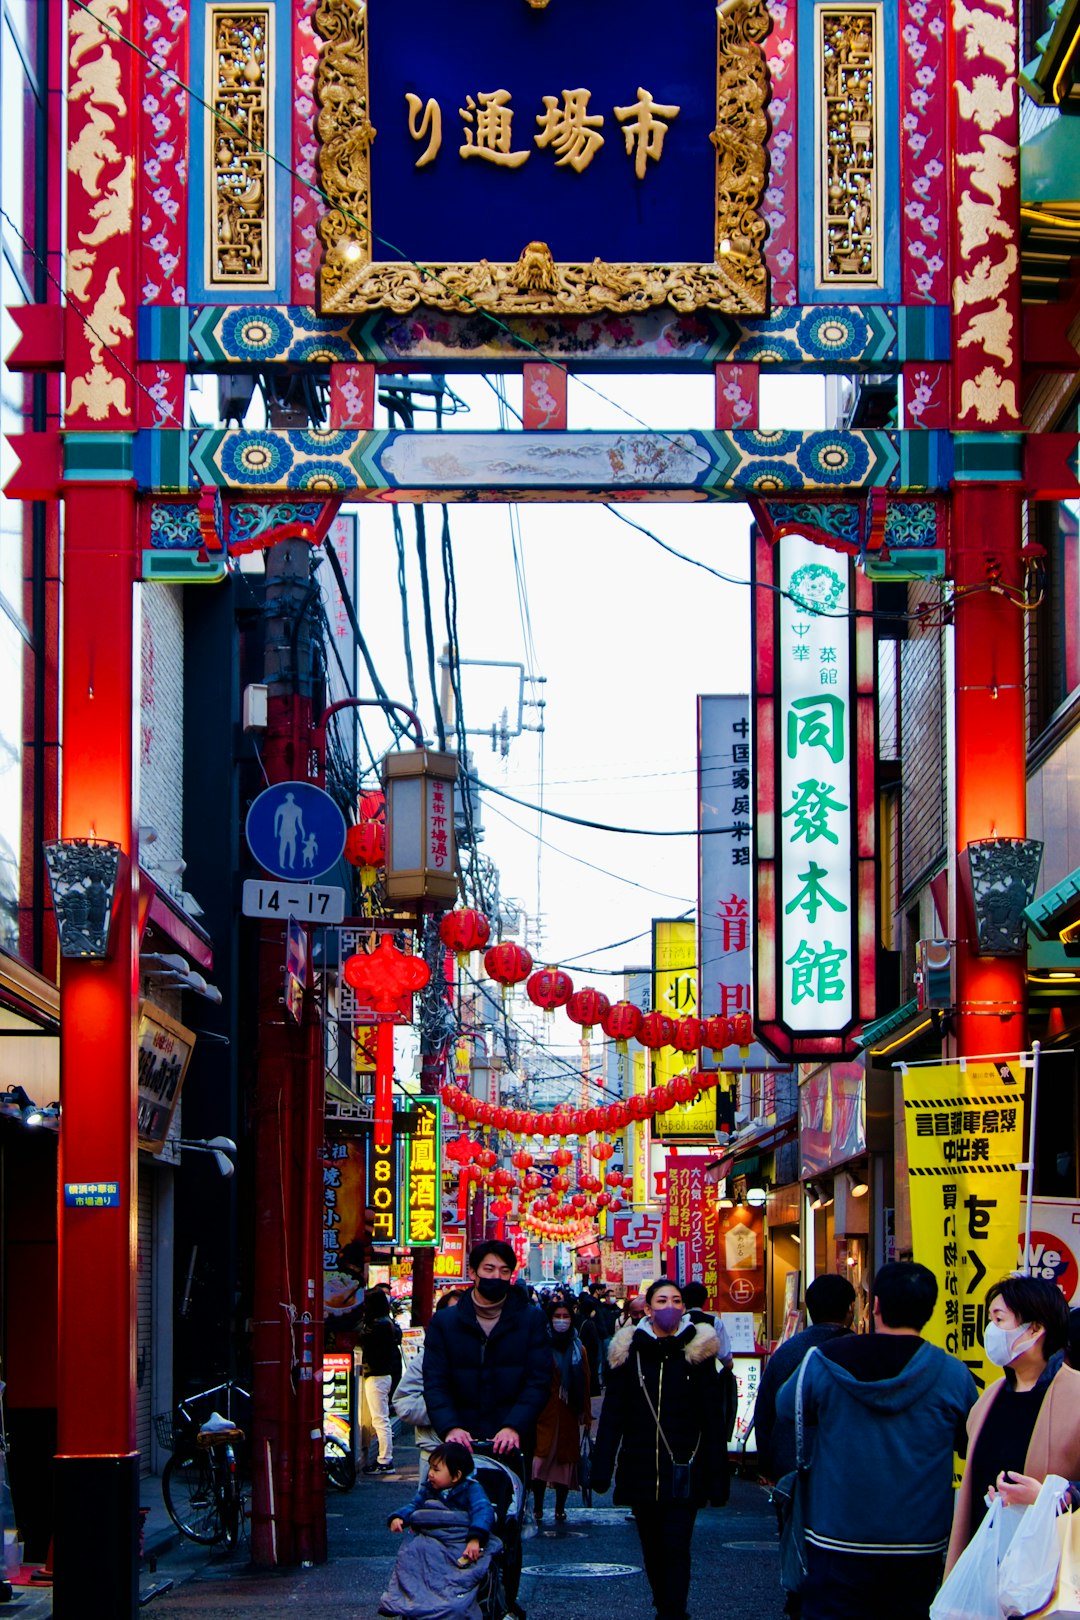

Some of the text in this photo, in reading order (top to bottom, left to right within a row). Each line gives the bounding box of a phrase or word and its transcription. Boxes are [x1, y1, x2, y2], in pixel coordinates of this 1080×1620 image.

[404, 87, 682, 180] 市場通り
[792, 622, 811, 661] 中華
[818, 646, 838, 685] 菜館
[431, 780, 448, 867] 中華街市場通り
[784, 693, 850, 1006] 同發本館
[258, 888, 331, 915] 14-17
